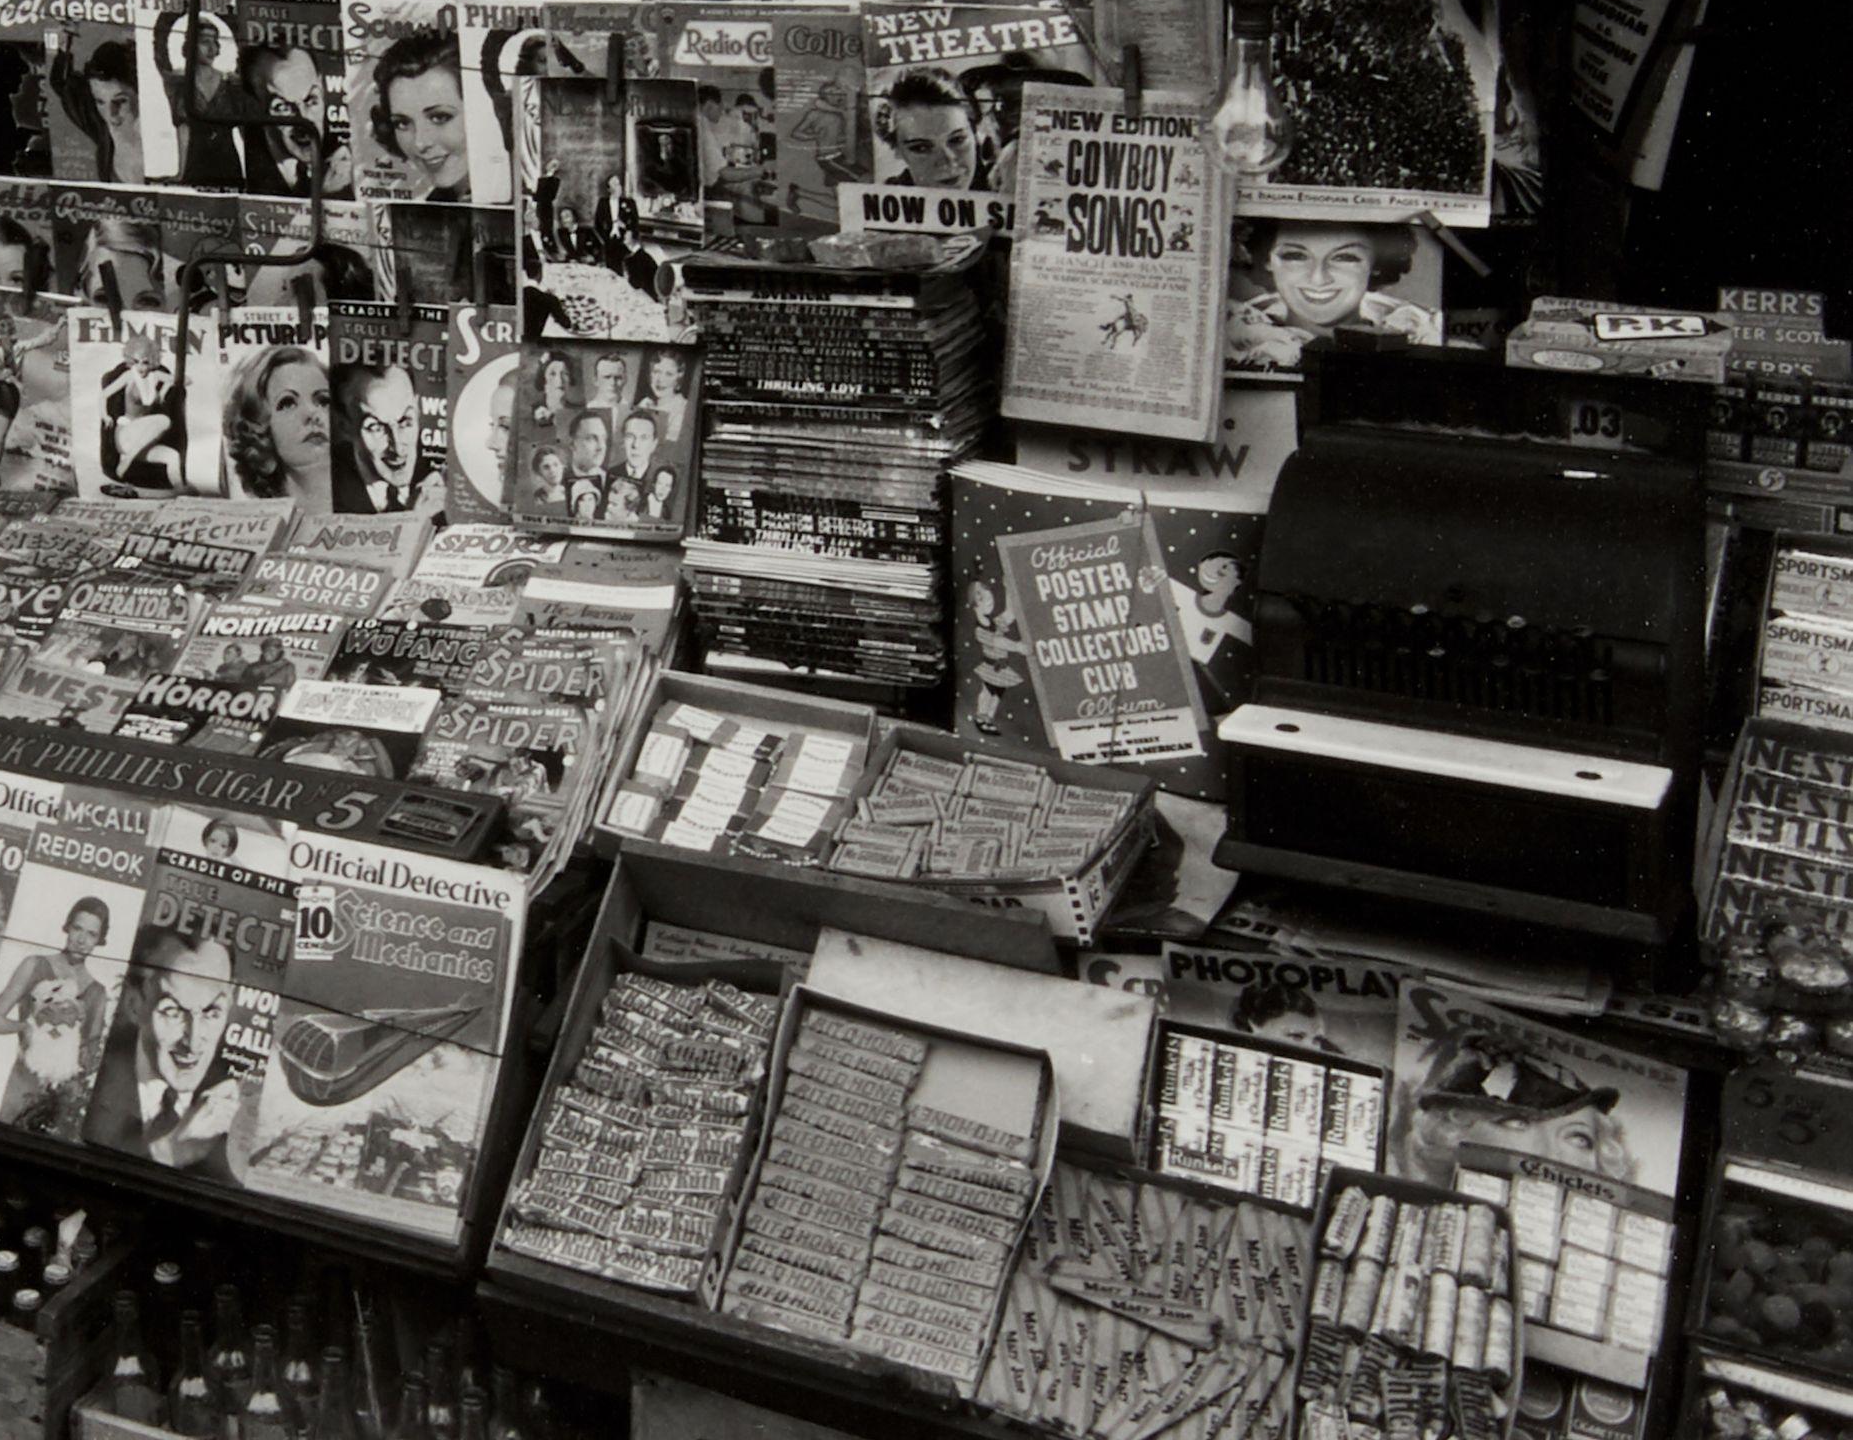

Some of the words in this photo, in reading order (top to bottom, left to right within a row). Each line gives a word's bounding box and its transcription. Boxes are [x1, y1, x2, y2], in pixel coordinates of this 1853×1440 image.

[877, 8, 952, 35] NEW
[879, 16, 1077, 65] THEATRE
[685, 30, 740, 56] Radio
[1053, 109, 1104, 133] NEW
[1109, 112, 1192, 140] EDITION
[1067, 139, 1174, 194] COWBOY
[165, 208, 236, 238] Mickey
[864, 195, 924, 225] NOW
[938, 197, 976, 227] ON
[1067, 194, 1167, 259] SONGS
[1719, 290, 1823, 316] KERR'S
[1607, 317, 1703, 336] P.K.
[1573, 405, 1621, 437] .03
[1031, 535, 1120, 570] Official
[257, 558, 381, 593] RAILROAD
[1035, 561, 1132, 602] POSTER
[72, 583, 172, 620] OPERATOR
[277, 583, 372, 609] STORIES
[1052, 595, 1129, 633] STAMP
[205, 613, 343, 638] NORTHWEST
[1035, 622, 1169, 667] COLLECTORS
[18, 667, 131, 713] WEST
[473, 646, 604, 698] SPIDER
[1081, 661, 1137, 695] CLUB
[139, 675, 275, 721] HORROR
[440, 703, 578, 755] SPIDER
[1135, 743, 1193, 755] AMERICAN
[45, 736, 199, 791] PHILLIES
[193, 766, 302, 810] CIGAR
[316, 791, 378, 832] 5
[35, 833, 143, 877] REDBOOK
[168, 852, 227, 879] CRADLE
[231, 870, 255, 882] OF
[259, 876, 289, 893] THE
[291, 841, 385, 885] Official
[389, 865, 511, 908] Detective
[298, 905, 333, 940] 10
[335, 890, 444, 945] Science
[447, 926, 493, 950] and
[352, 935, 494, 983] Mechanics
[1169, 950, 1400, 997] PHOTOPLAY
[1410, 988, 1677, 1083] SCREENLAND
[1519, 1160, 1614, 1202] Chiclets
[1111, 1299, 1154, 1315] Mary
[1159, 1307, 1194, 1321] Jane
